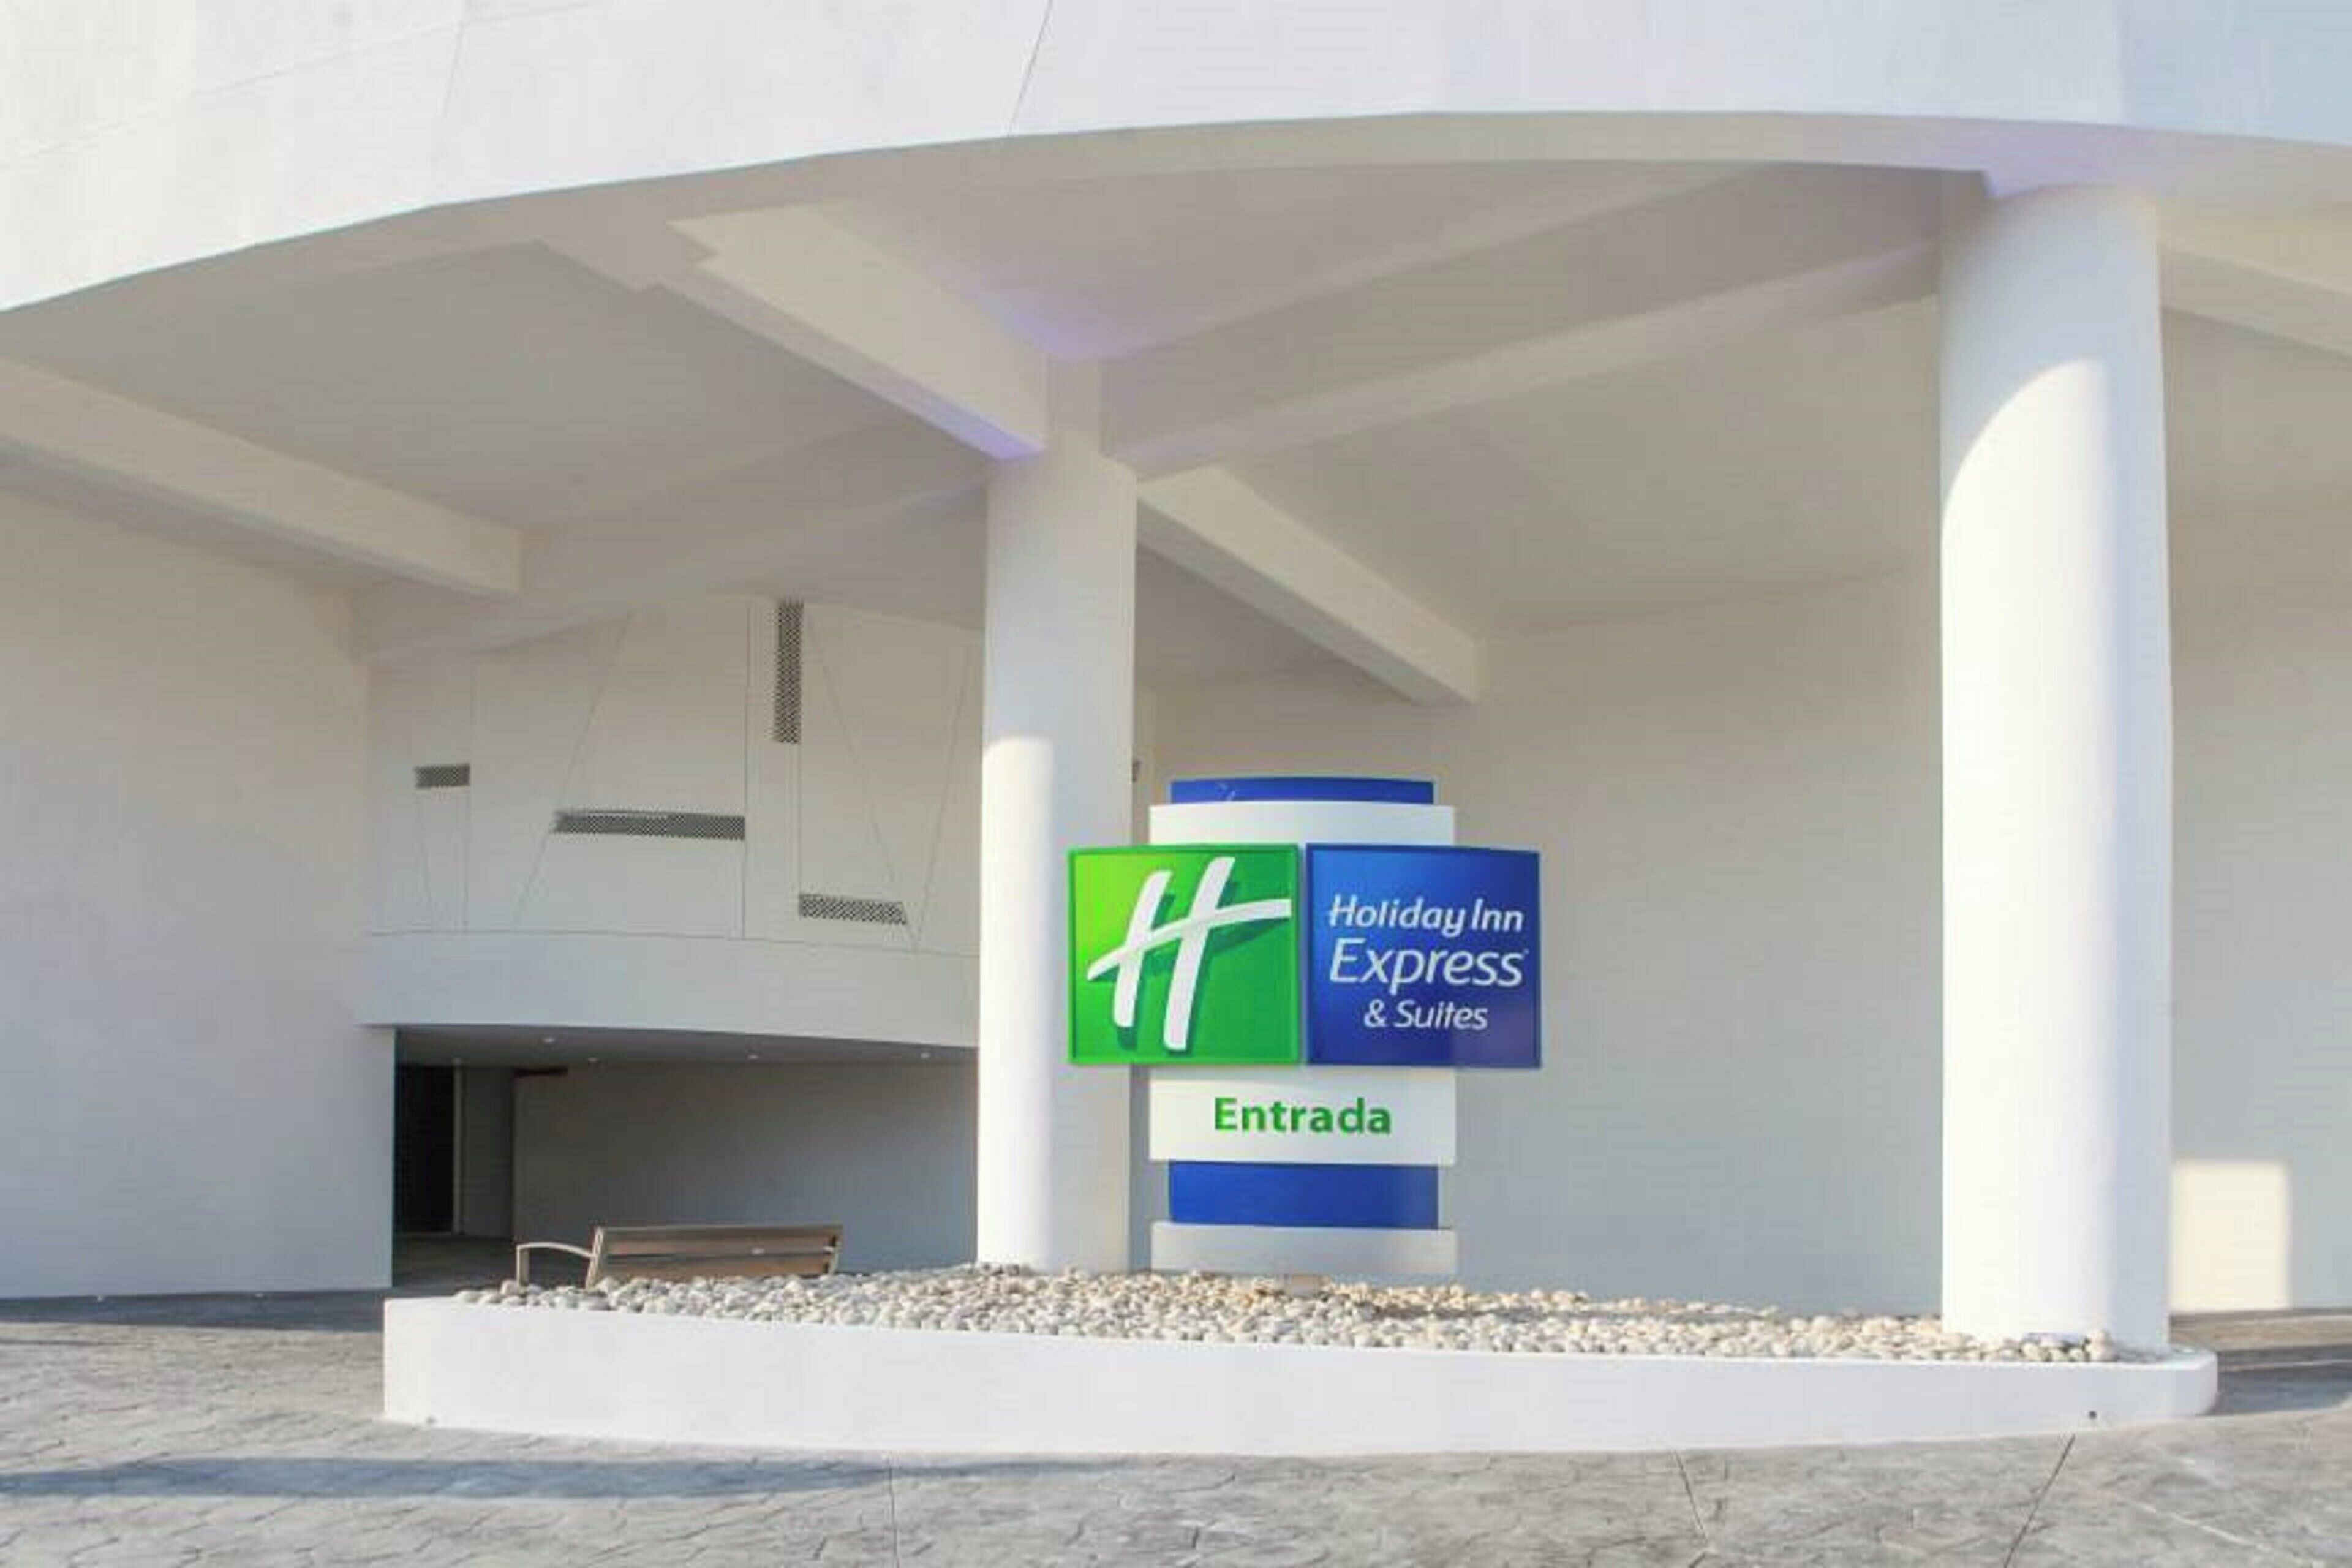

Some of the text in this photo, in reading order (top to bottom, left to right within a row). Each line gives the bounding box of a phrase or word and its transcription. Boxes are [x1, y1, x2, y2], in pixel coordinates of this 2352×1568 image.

[1329, 893, 1524, 937] Holiday Inn
[1087, 858, 1292, 1051] H
[1330, 938, 1524, 995] Express
[1364, 1000, 1488, 1030] & Suites
[1214, 1097, 1392, 1134] Entrada
